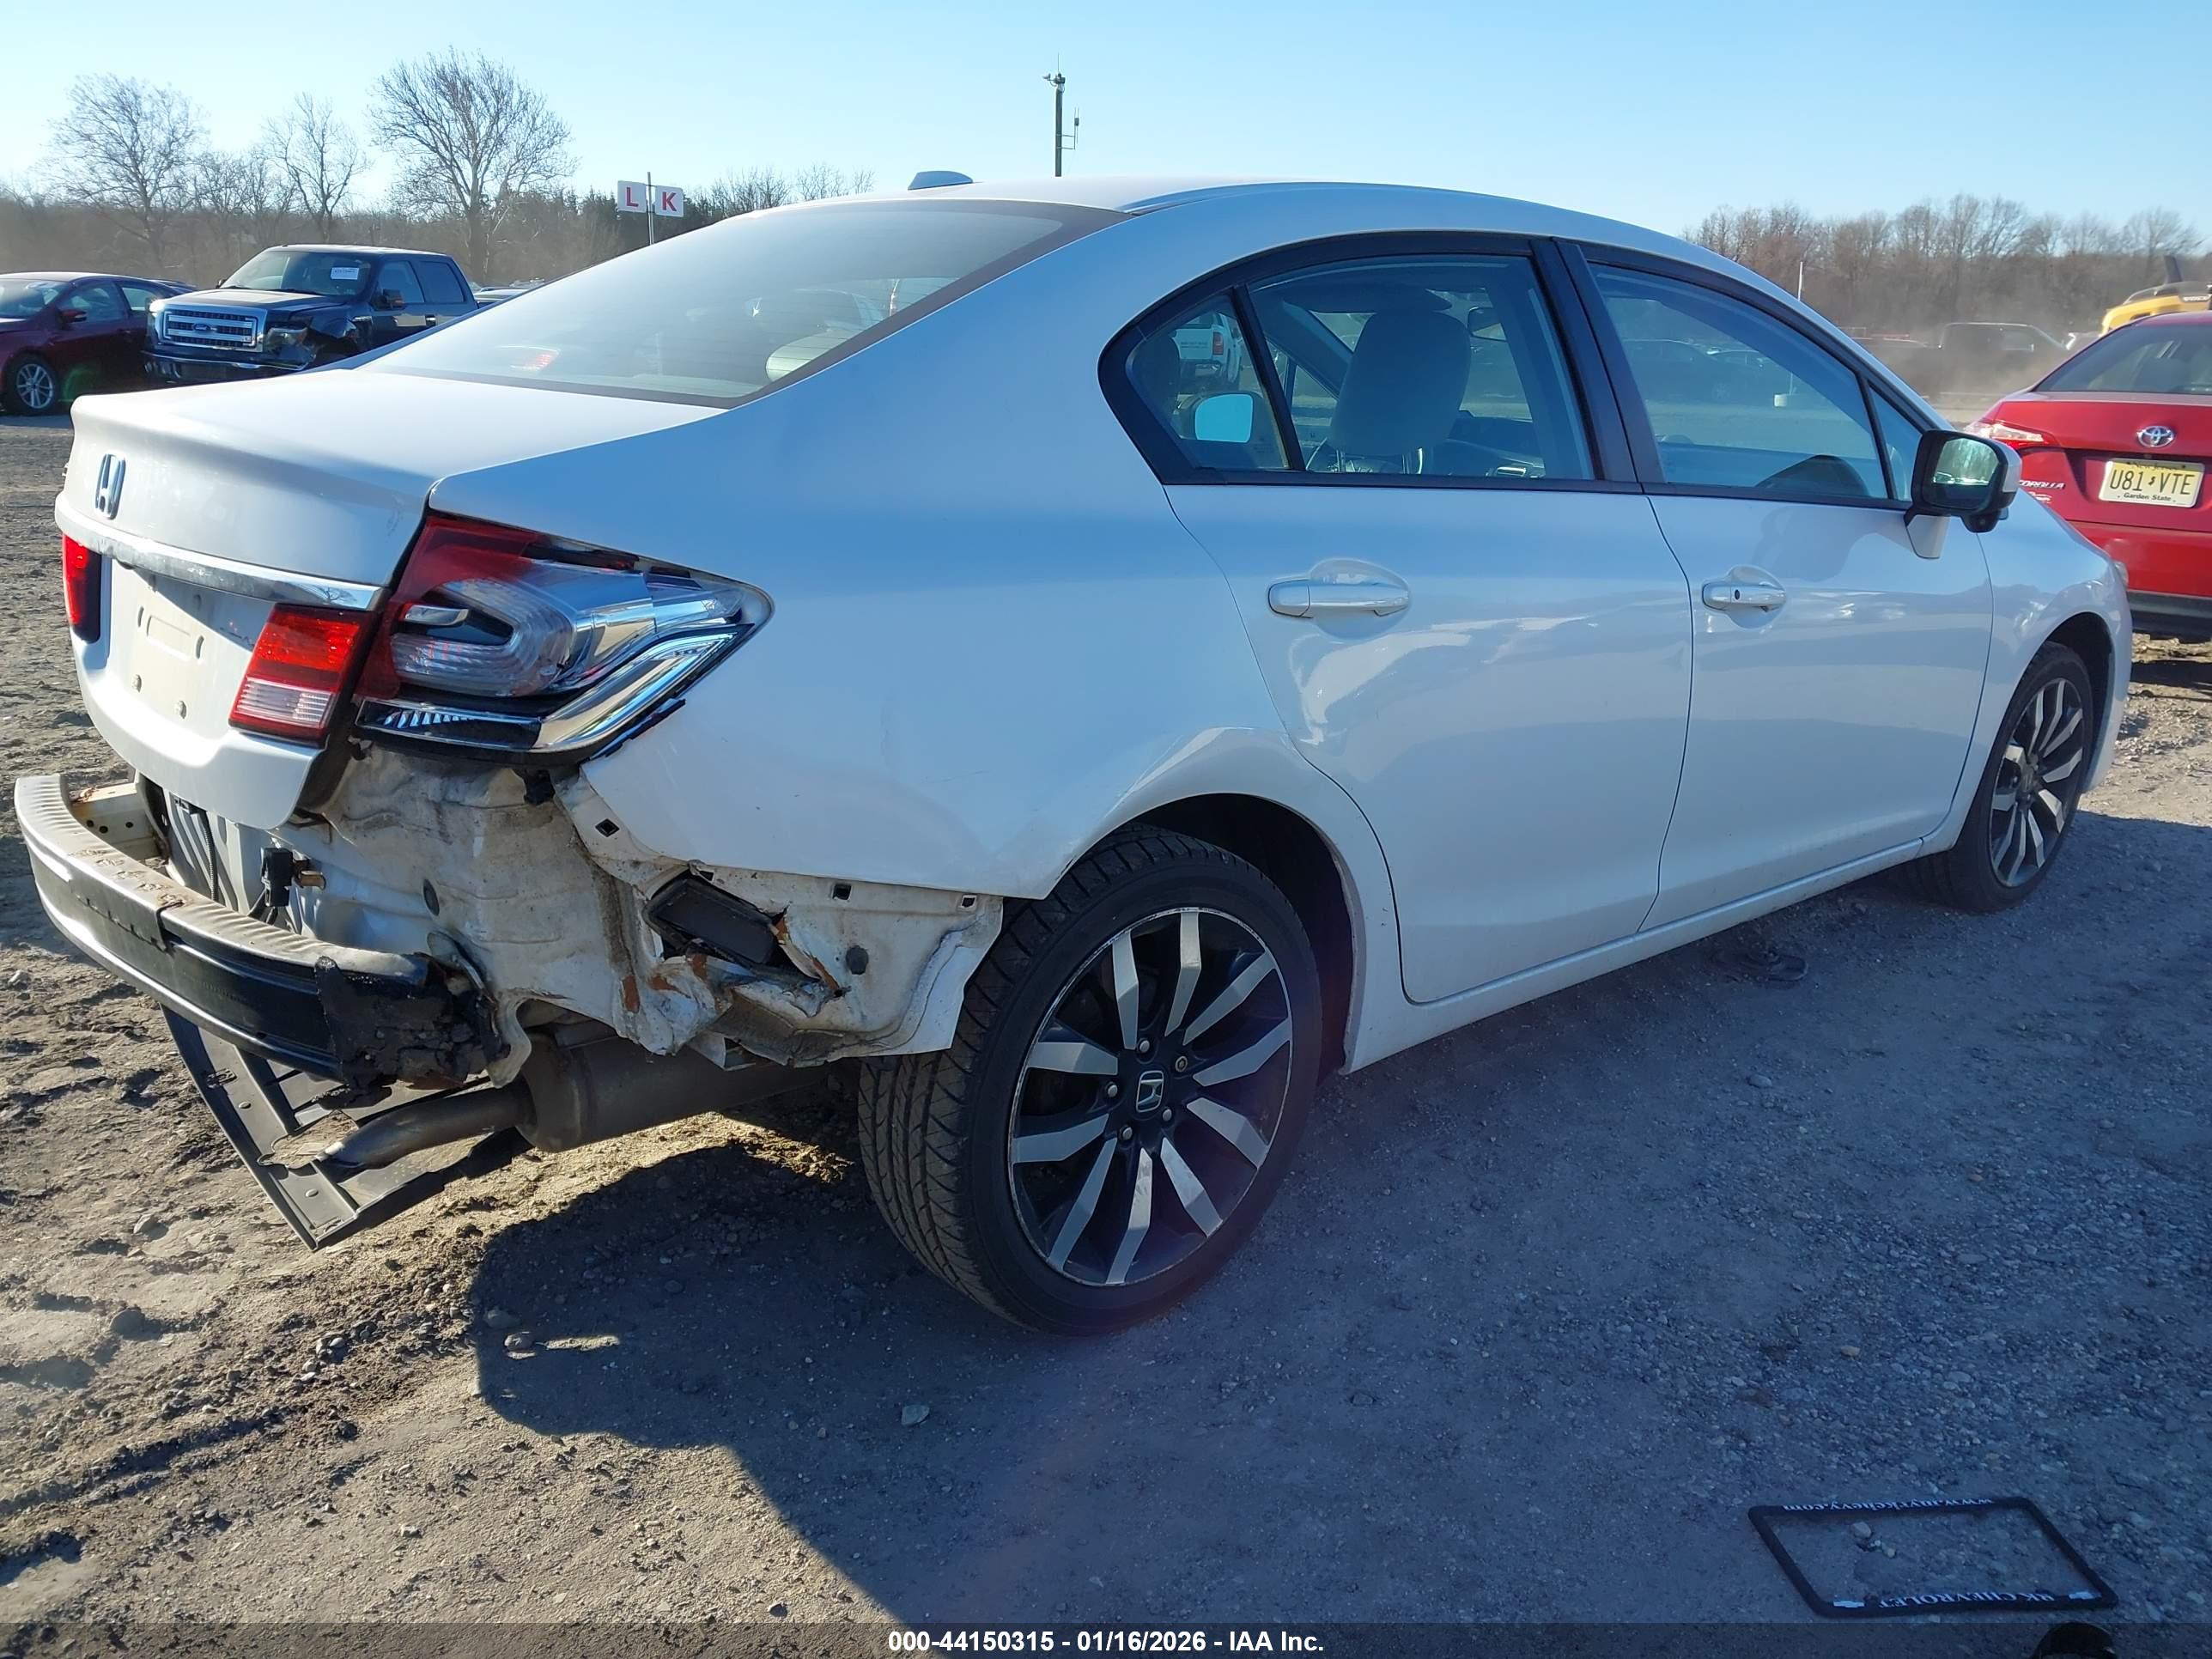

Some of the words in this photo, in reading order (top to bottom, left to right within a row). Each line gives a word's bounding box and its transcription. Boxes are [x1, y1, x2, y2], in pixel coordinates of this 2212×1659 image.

[626, 186, 639, 207] L
[662, 191, 677, 211] K
[2109, 469, 2144, 492] U81
[2160, 471, 2196, 495] VTE
[1879, 1592, 2017, 1608] CHEVROLET
